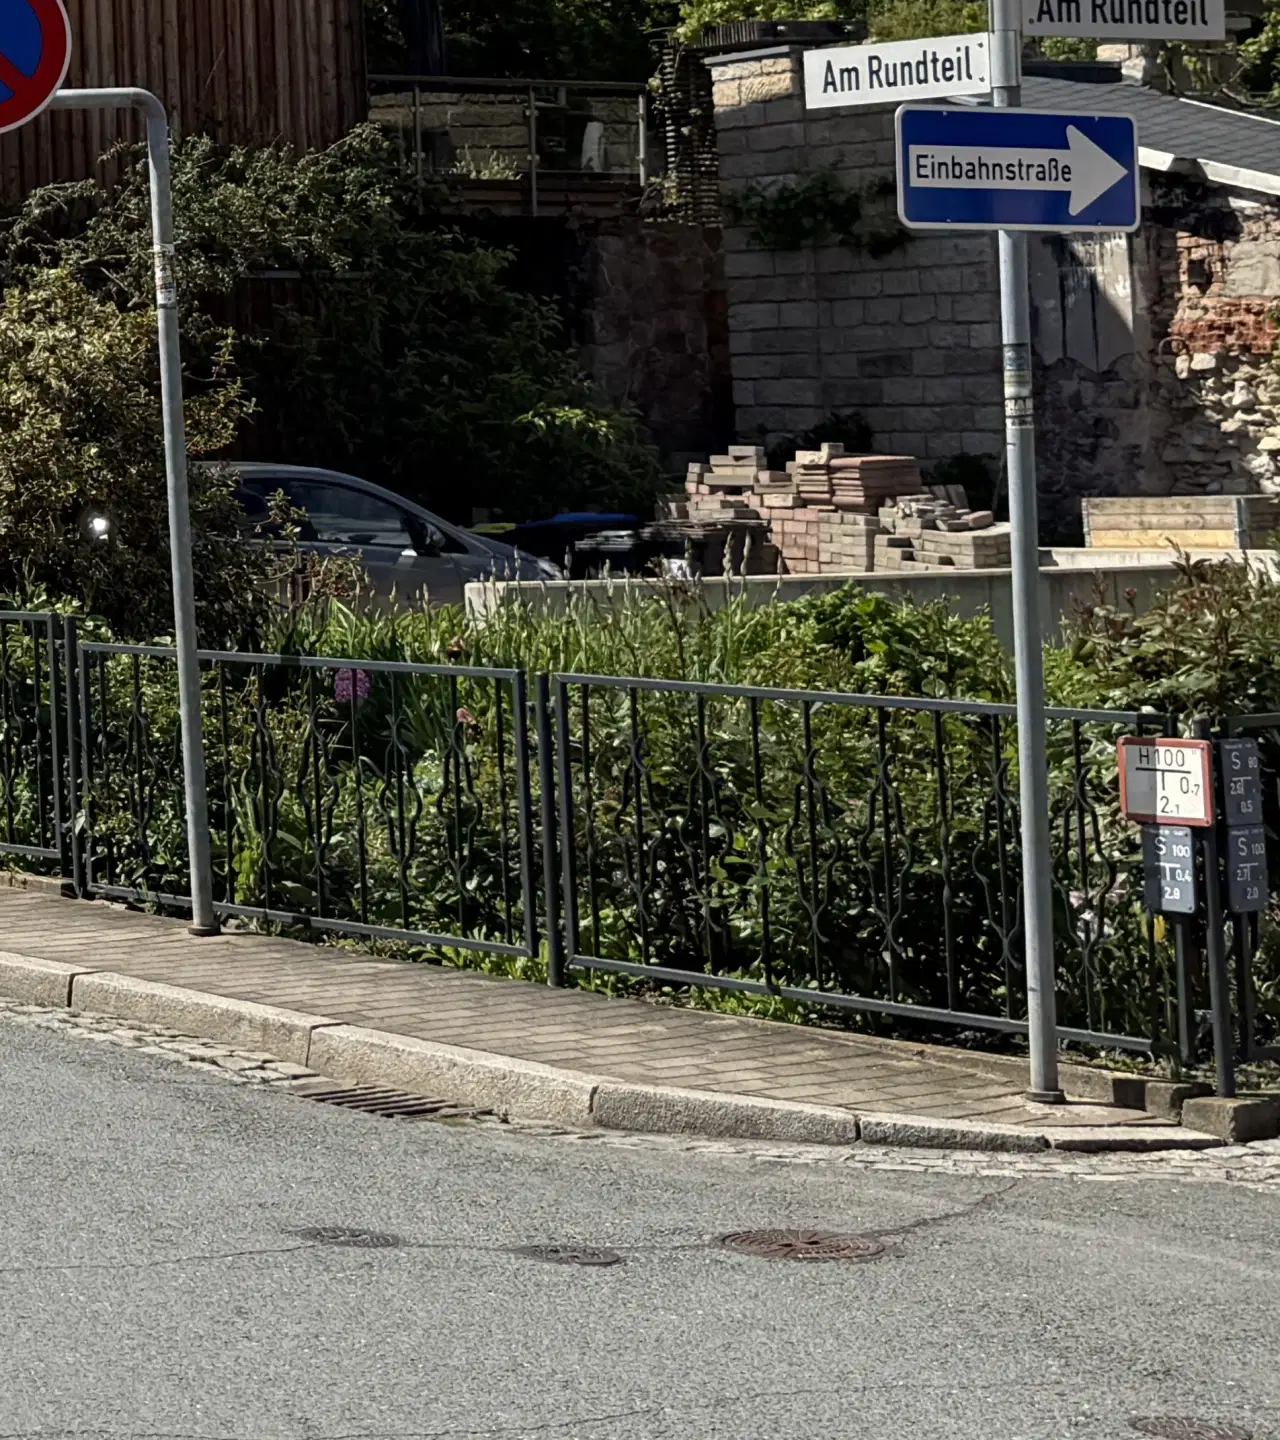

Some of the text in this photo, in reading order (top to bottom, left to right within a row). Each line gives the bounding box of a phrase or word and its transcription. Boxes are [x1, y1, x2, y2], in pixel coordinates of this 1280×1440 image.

[822, 45, 973, 94] Am Rundteil
[915, 154, 1072, 183] Einbahnstraße
[1231, 751, 1241, 770] S
[1155, 836, 1191, 858] S 100
[1238, 836, 1248, 857] S
